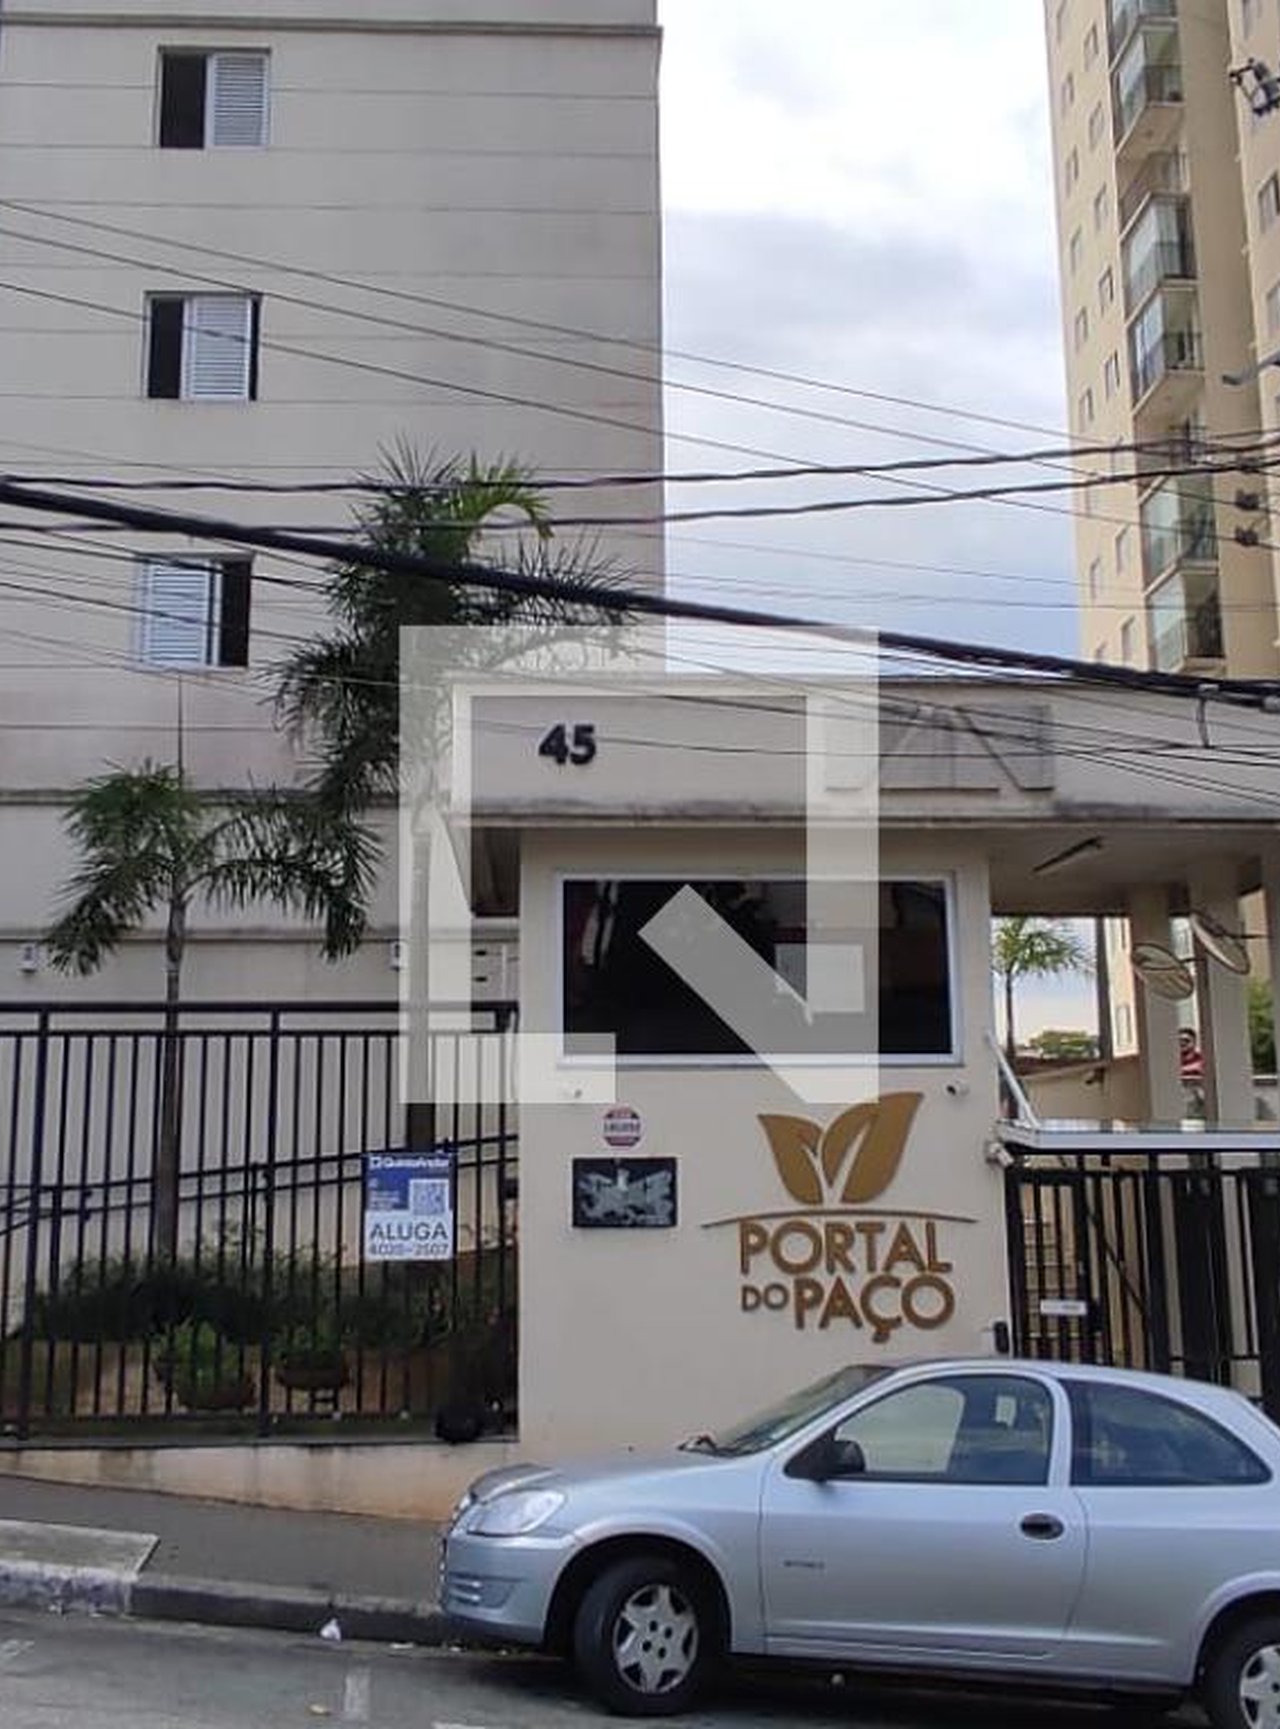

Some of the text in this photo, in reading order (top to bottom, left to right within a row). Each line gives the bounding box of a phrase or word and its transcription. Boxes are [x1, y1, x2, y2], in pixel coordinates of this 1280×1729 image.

[539, 725, 596, 765] 45
[370, 1222, 448, 1240] ALUGA
[739, 1220, 953, 1275] PORTAL
[741, 1274, 955, 1343] DO PAÇO
